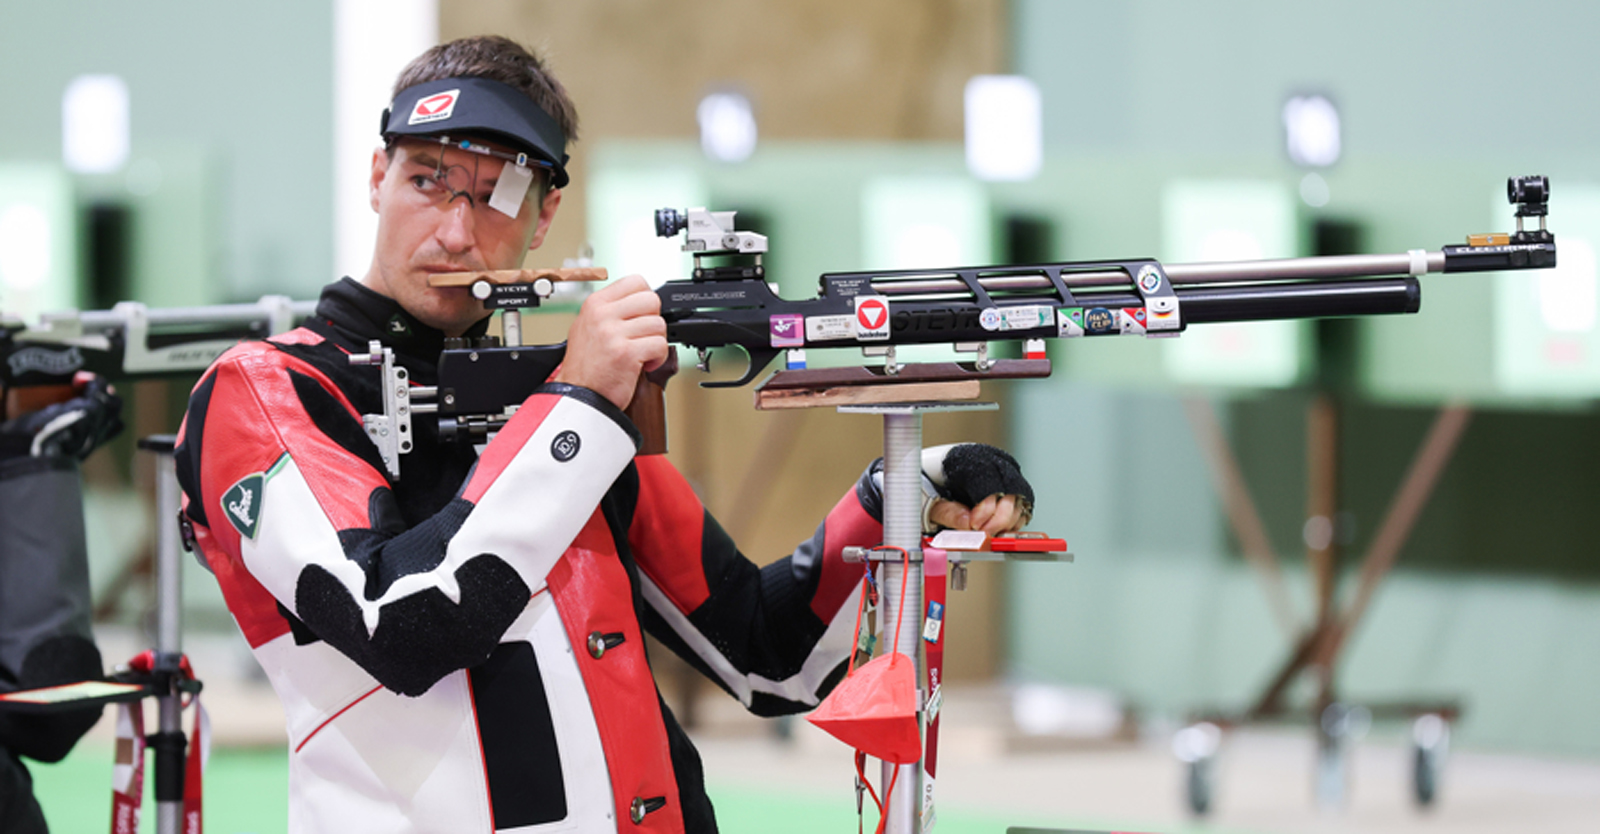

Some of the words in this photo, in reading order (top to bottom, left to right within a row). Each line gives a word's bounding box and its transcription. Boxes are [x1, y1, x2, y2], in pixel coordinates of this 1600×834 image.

[1456, 244, 1546, 253] ELECTRONIC
[671, 291, 746, 301] CHALLENGE
[893, 307, 981, 331] STEYR
